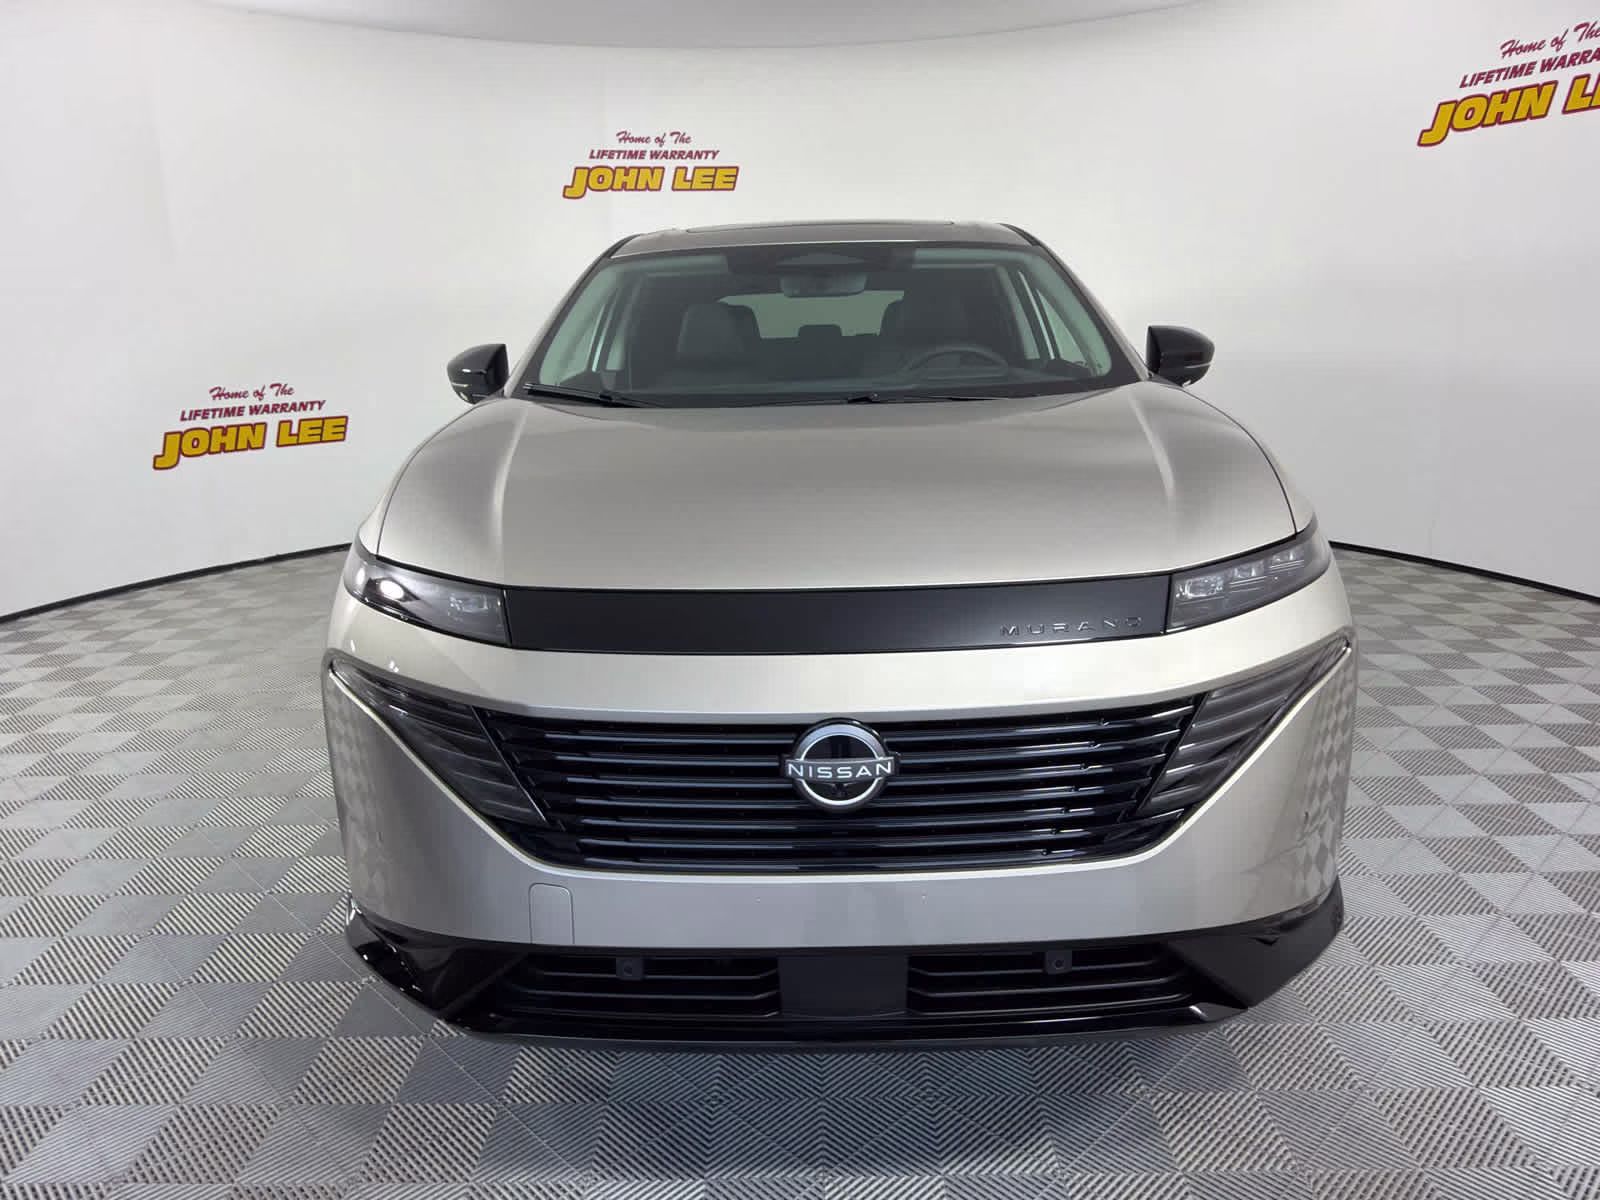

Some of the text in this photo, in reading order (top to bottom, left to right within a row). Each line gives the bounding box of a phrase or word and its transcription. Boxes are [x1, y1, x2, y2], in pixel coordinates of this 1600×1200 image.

[1500, 39, 1546, 59] Home
[1550, 28, 1569, 51] of
[1459, 61, 1537, 88] LIFETIME
[1417, 80, 1558, 147] JOHN
[616, 131, 692, 147] Home of The
[589, 150, 720, 160] LIFETIME WARRANTY
[562, 165, 739, 199] JOHN LEE
[209, 382, 295, 401] Home of The
[180, 400, 327, 422] LIFETIME WARRANTY
[153, 415, 349, 470] JOHN LEE
[1001, 616, 1142, 636] MURANO
[787, 761, 892, 779] NISSAN
